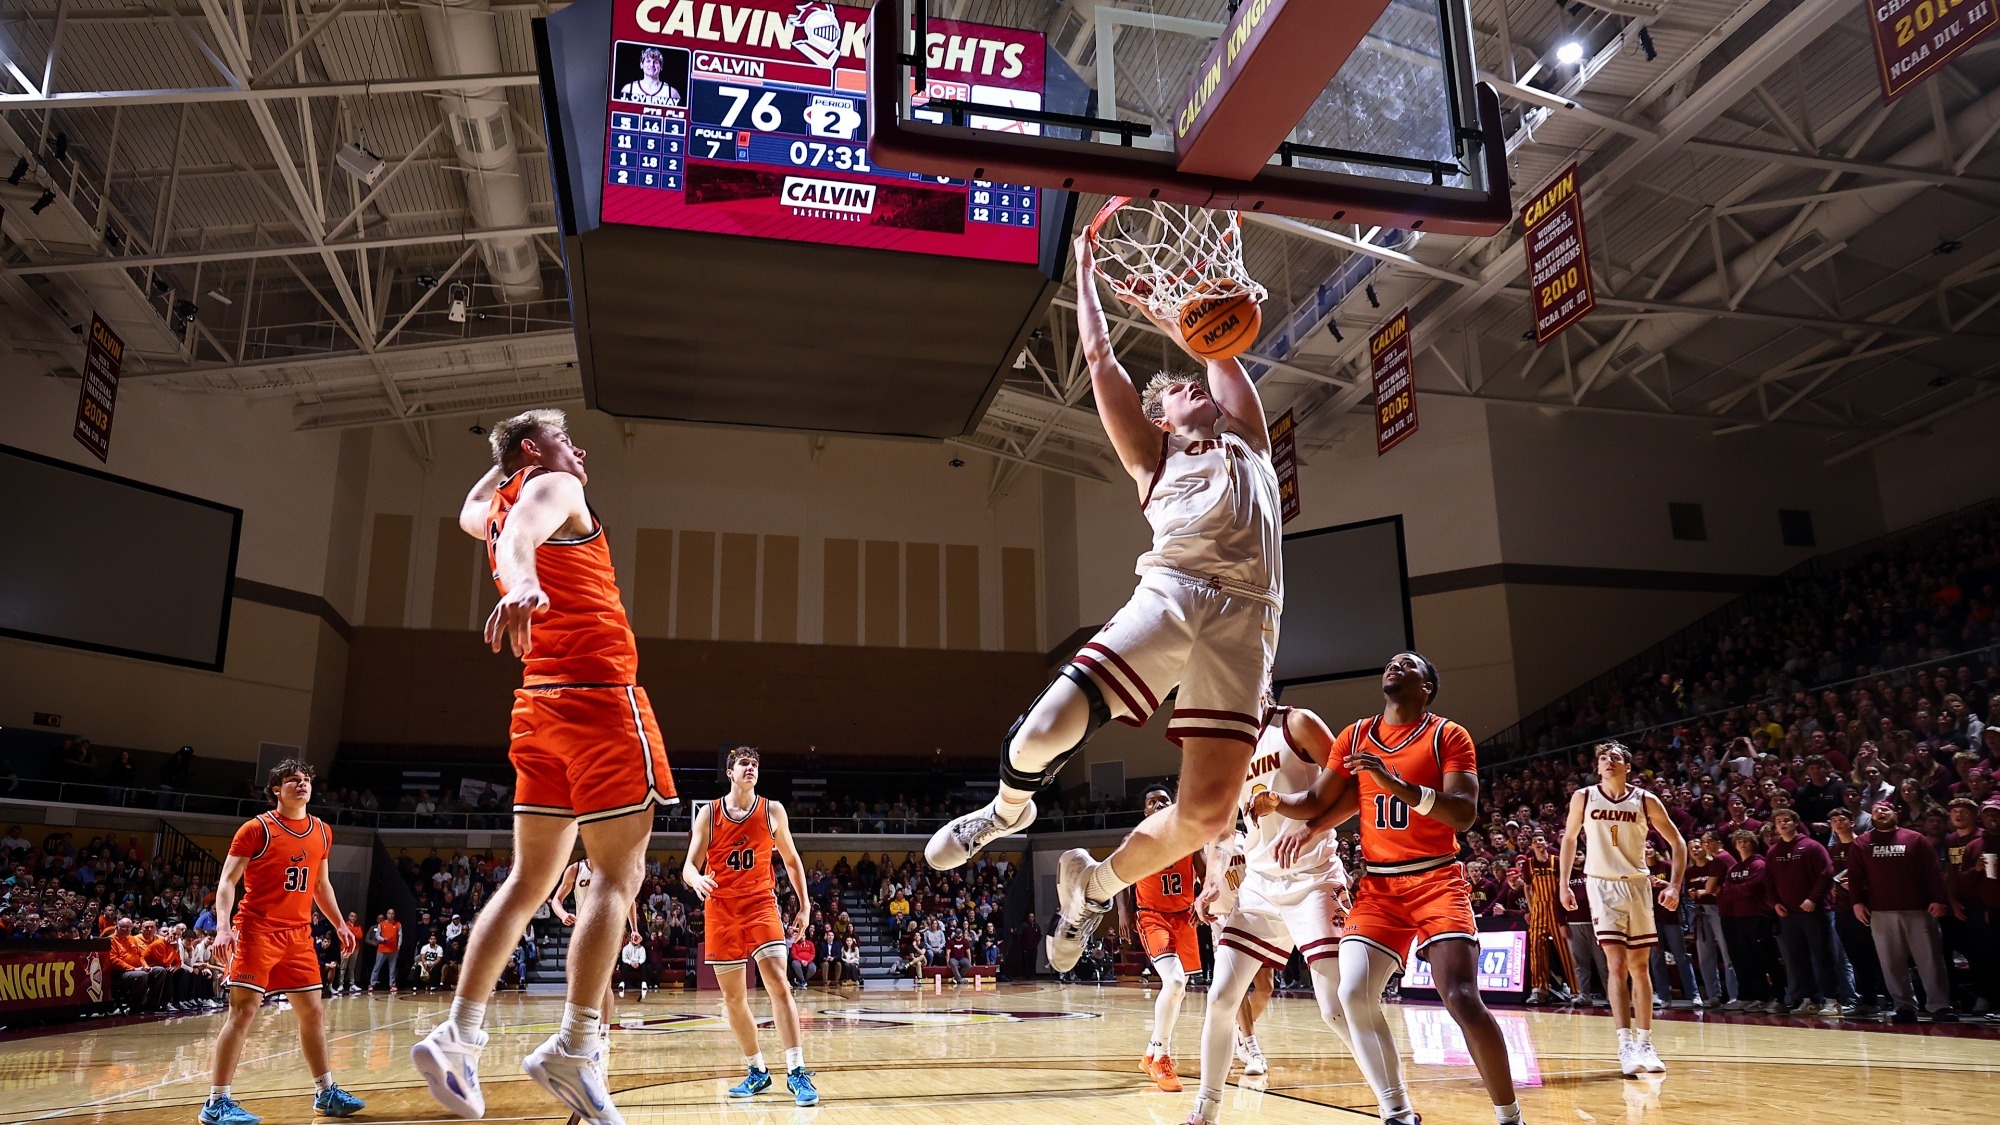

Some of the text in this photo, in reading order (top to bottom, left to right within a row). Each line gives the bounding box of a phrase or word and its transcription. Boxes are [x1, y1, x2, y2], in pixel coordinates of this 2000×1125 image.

[1894, 0, 1963, 48] 201
[635, 0, 1025, 79] CALVIN KGHTS
[1890, 43, 1931, 80] NCAA
[1933, 19, 1964, 50] DIV.
[696, 55, 765, 78] CALVIN
[620, 92, 680, 107] J. OVERWAY
[815, 98, 852, 109] PERIOD
[1179, 54, 1222, 139] CALVIN
[643, 107, 662, 116] PTS
[718, 86, 782, 132] 76
[620, 117, 679, 135] 5 16 3
[695, 128, 733, 141] FOULS
[823, 111, 841, 134] 2
[617, 135, 678, 152] 11 5 3
[706, 141, 720, 159] 7
[619, 152, 678, 170] 1 18 2
[789, 141, 871, 173] 07:31
[617, 170, 677, 188] 2 5 1
[787, 182, 870, 208] CALVIN
[973, 191, 1031, 208] 10 2 0
[1525, 171, 1575, 227] CALVIN
[793, 207, 862, 222] BASKETBALL
[973, 208, 1030, 225] 12 2 2
[1537, 210, 1567, 240] WOMEN'S
[1533, 217, 1574, 254] VOLLEYBALL
[1532, 243, 1581, 288] CHAMPIONS
[1534, 234, 1578, 273] NATIONAL
[1541, 266, 1579, 309] 2010
[1202, 313, 1240, 346] NCAA
[1539, 310, 1561, 331] NCAA
[93, 321, 121, 361] CALVIN
[1372, 314, 1406, 355] CALVIN
[84, 398, 109, 431] 2003
[1381, 391, 1409, 424] 2006
[1373, 793, 1410, 830] 10
[1590, 808, 1639, 823] CALVIN
[1610, 824, 1619, 847] 1
[726, 848, 755, 872] 40
[1873, 844, 1907, 854] CALVIN
[283, 866, 309, 893] 31
[1161, 872, 1183, 896] 12
[1225, 869, 1241, 891] 11
[1483, 951, 1506, 975] 67
